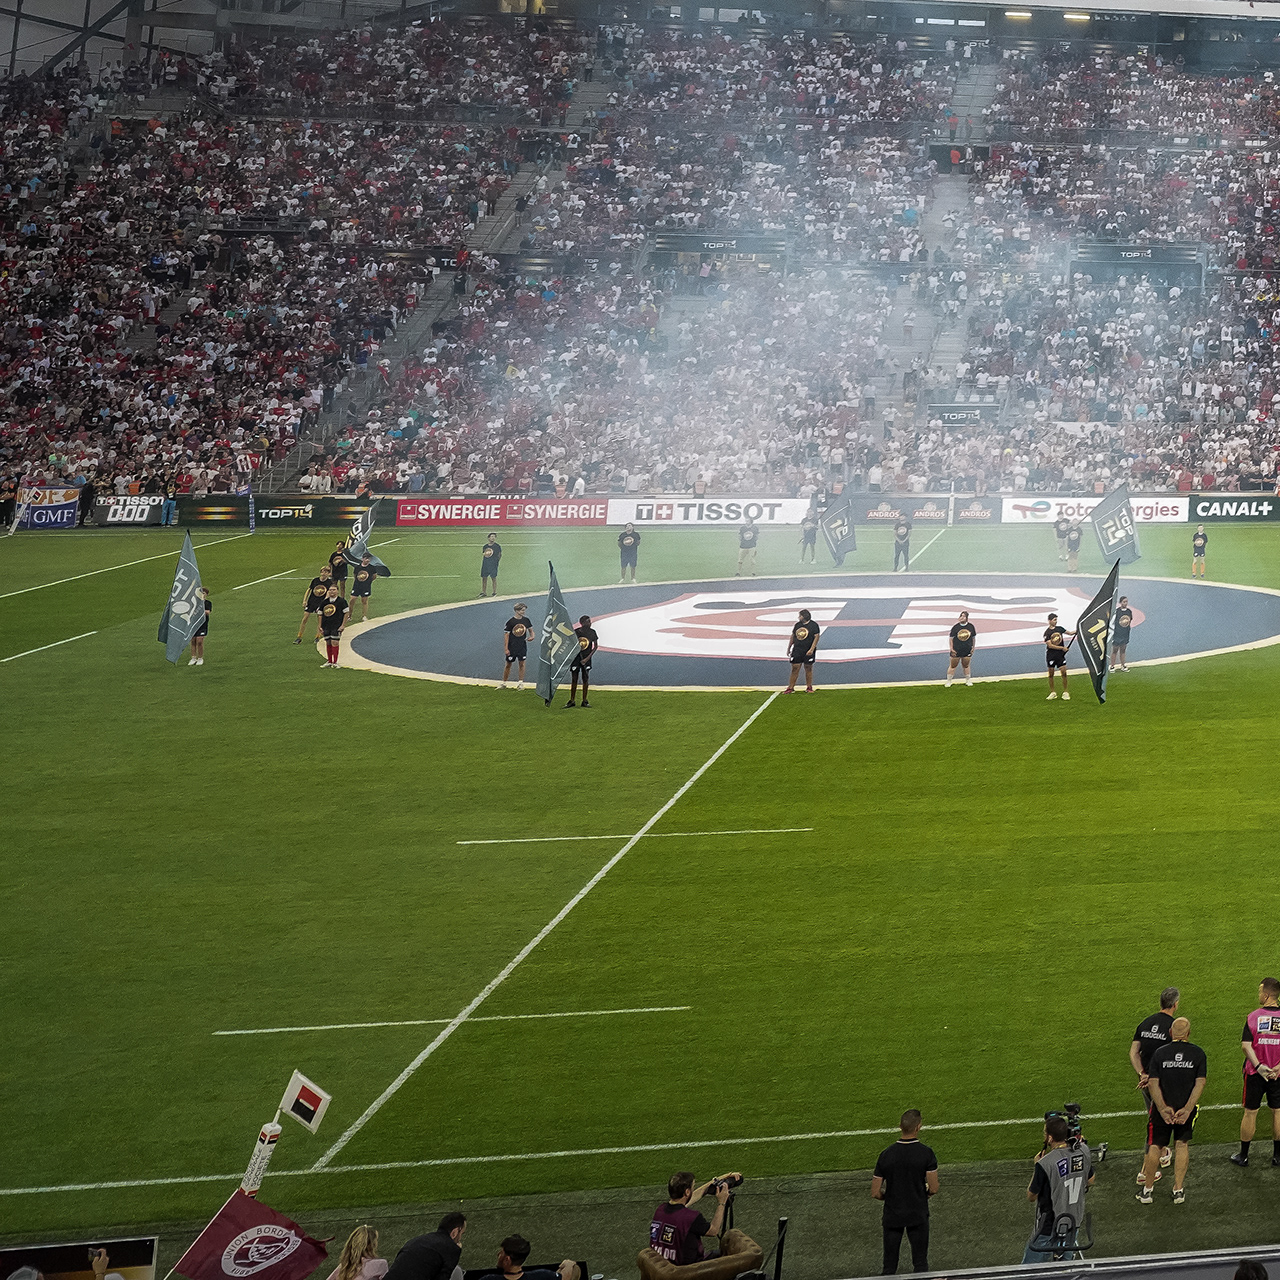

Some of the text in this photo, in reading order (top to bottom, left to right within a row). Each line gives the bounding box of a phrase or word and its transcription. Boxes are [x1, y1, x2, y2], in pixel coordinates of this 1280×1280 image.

[417, 503, 500, 519] SYNERGIE
[523, 503, 606, 519] SYNERGIE
[677, 503, 782, 520] TISSOT
[1196, 501, 1273, 516] CANAL+
[33, 509, 74, 524] GMF
[1141, 1032, 1166, 1041] FIDUCIAL
[1163, 1060, 1194, 1069] FIDUCIAL
[224, 1233, 249, 1260] UNION
